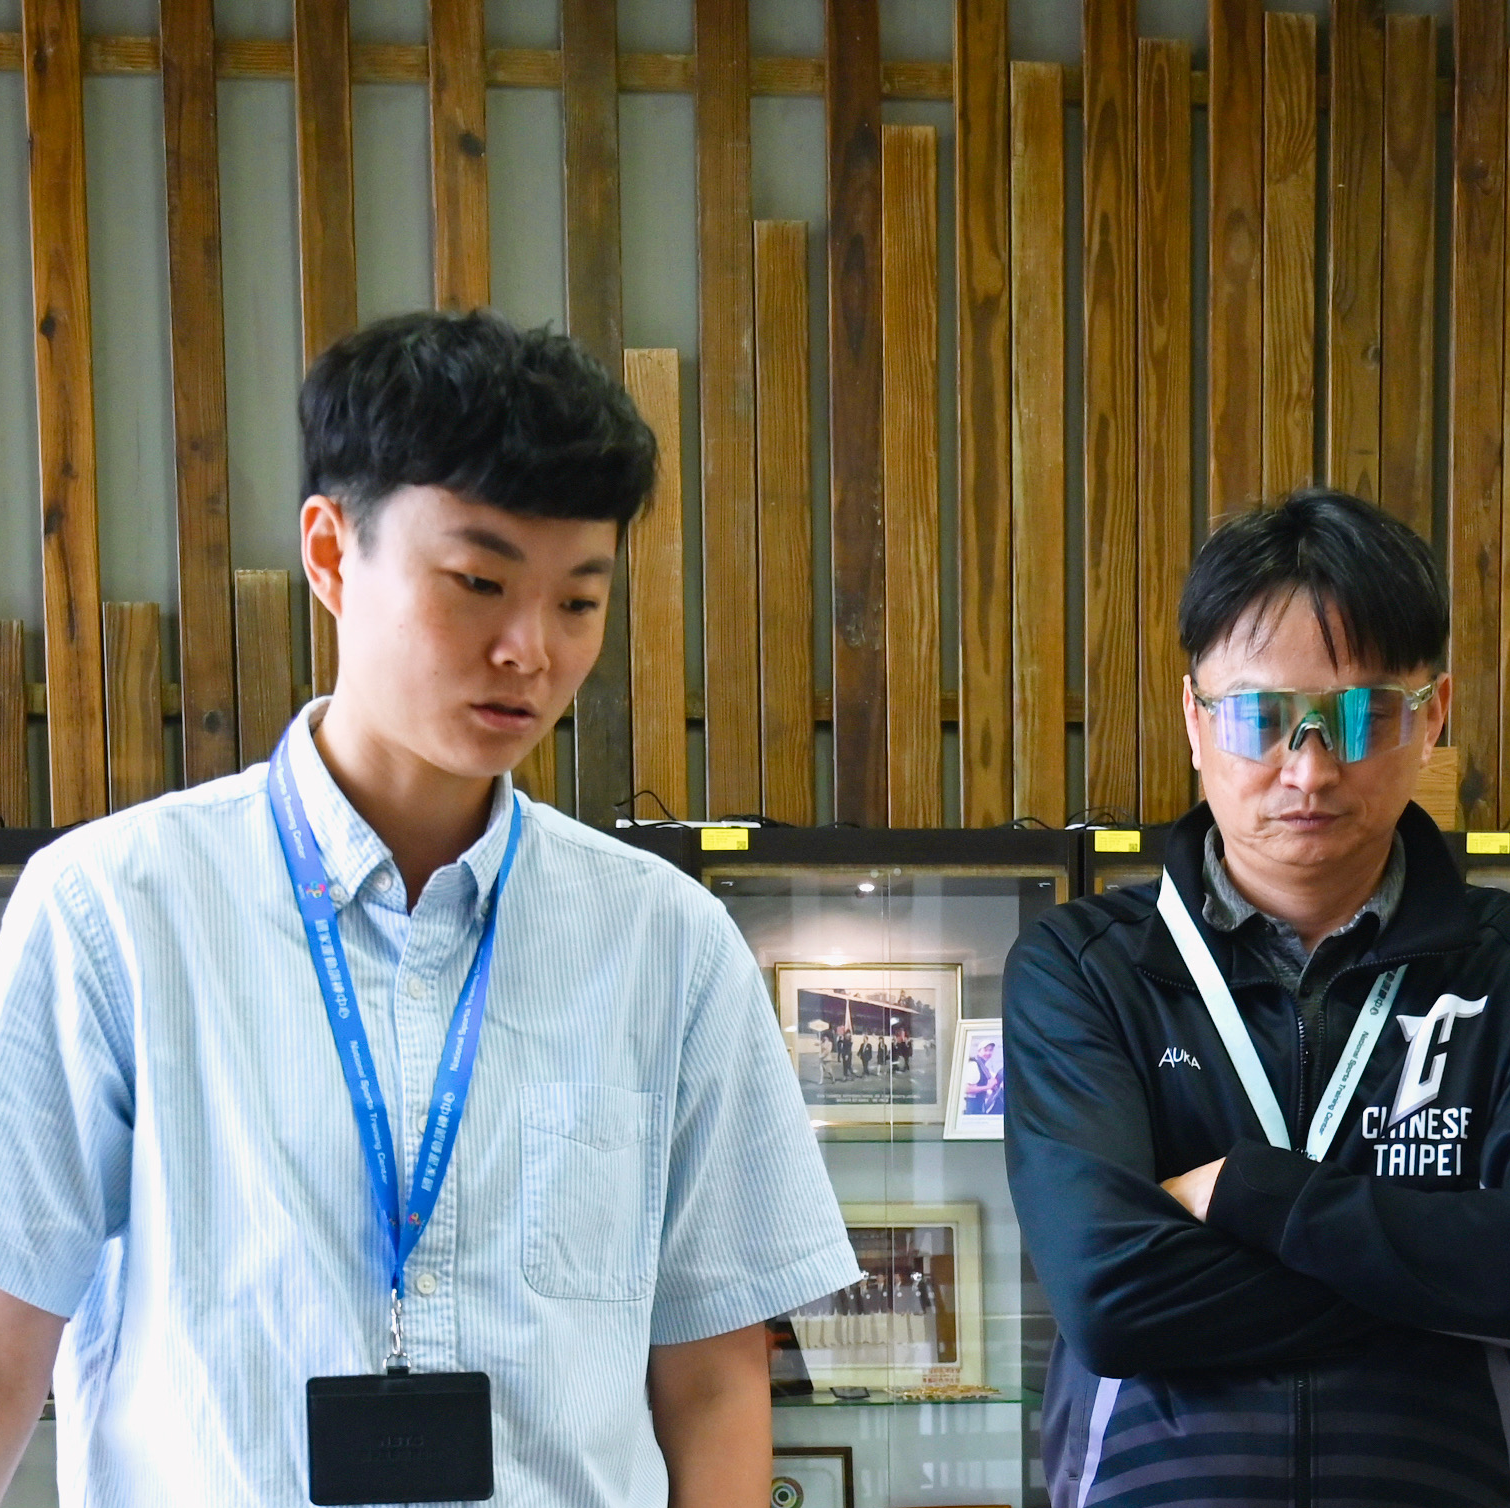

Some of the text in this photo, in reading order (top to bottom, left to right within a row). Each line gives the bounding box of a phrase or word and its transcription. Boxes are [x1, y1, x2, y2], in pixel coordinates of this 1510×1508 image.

[449, 1036, 465, 1072] National
[457, 1007, 472, 1036] Sports
[1158, 1047, 1201, 1070] AUKA
[349, 1039, 391, 1184] National Sports Training Center
[1317, 1030, 1369, 1136] National Sports Training Center
[1373, 1144, 1462, 1177] TAIPEI
